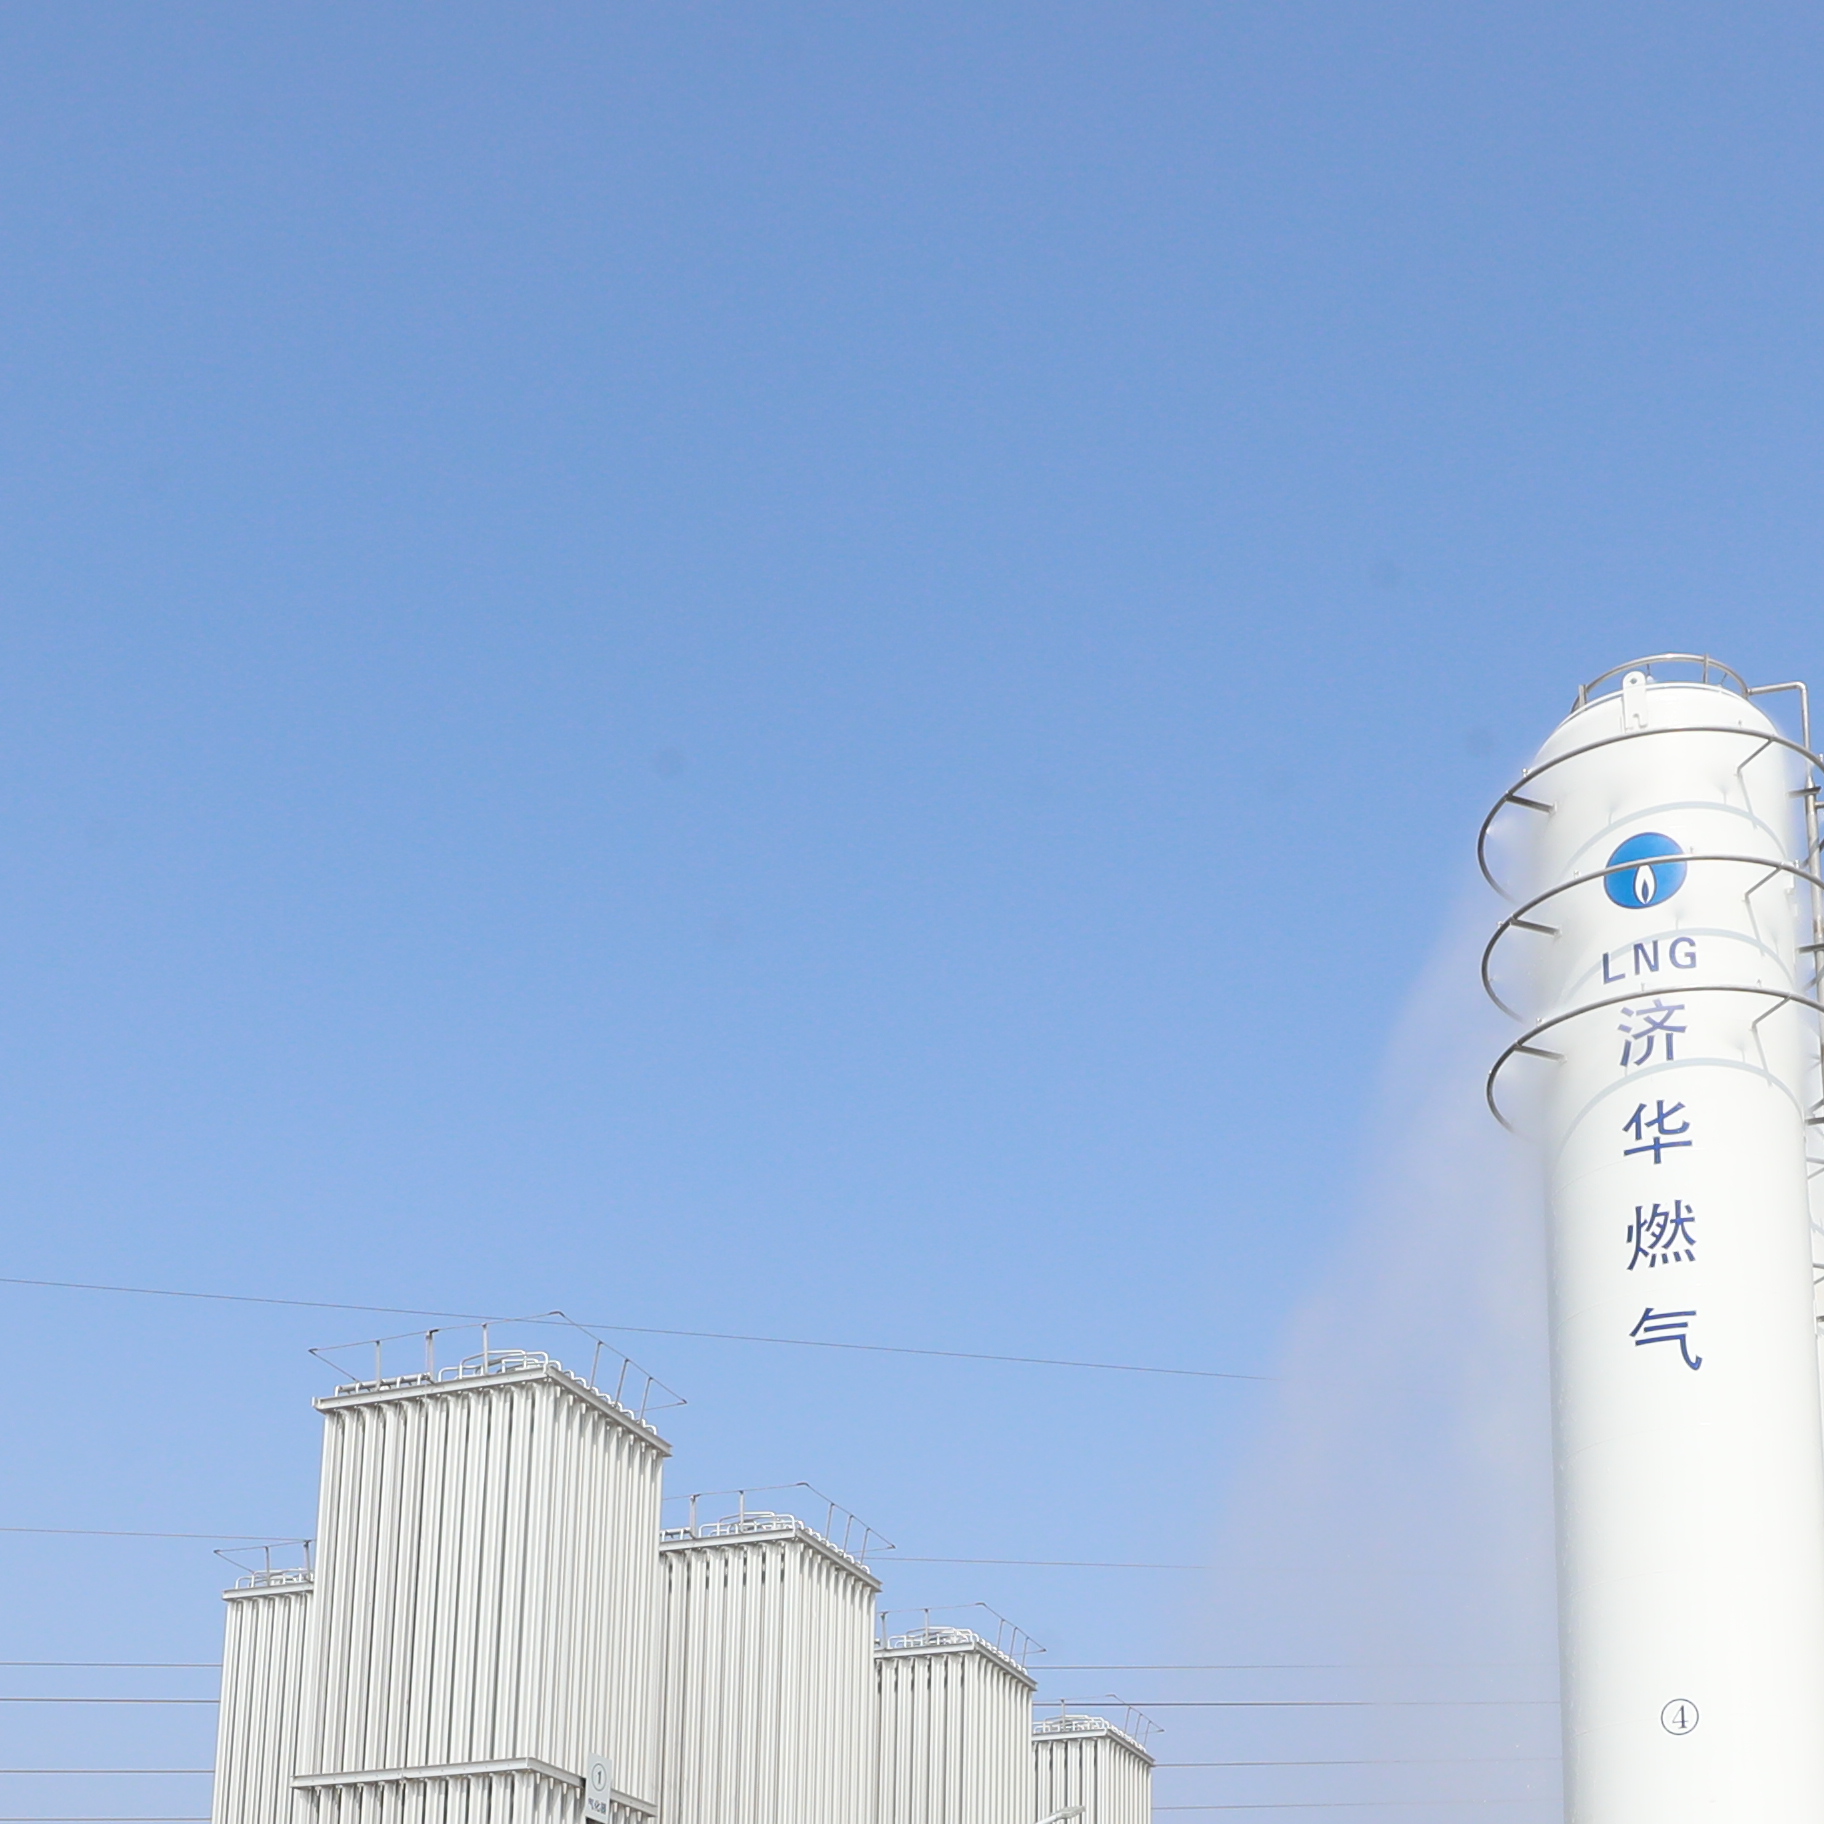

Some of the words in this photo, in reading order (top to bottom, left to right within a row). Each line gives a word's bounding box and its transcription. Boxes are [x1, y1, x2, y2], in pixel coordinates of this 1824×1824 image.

[1602, 936, 1698, 985] LNG
[1617, 998, 1703, 1371] 济华燃气
